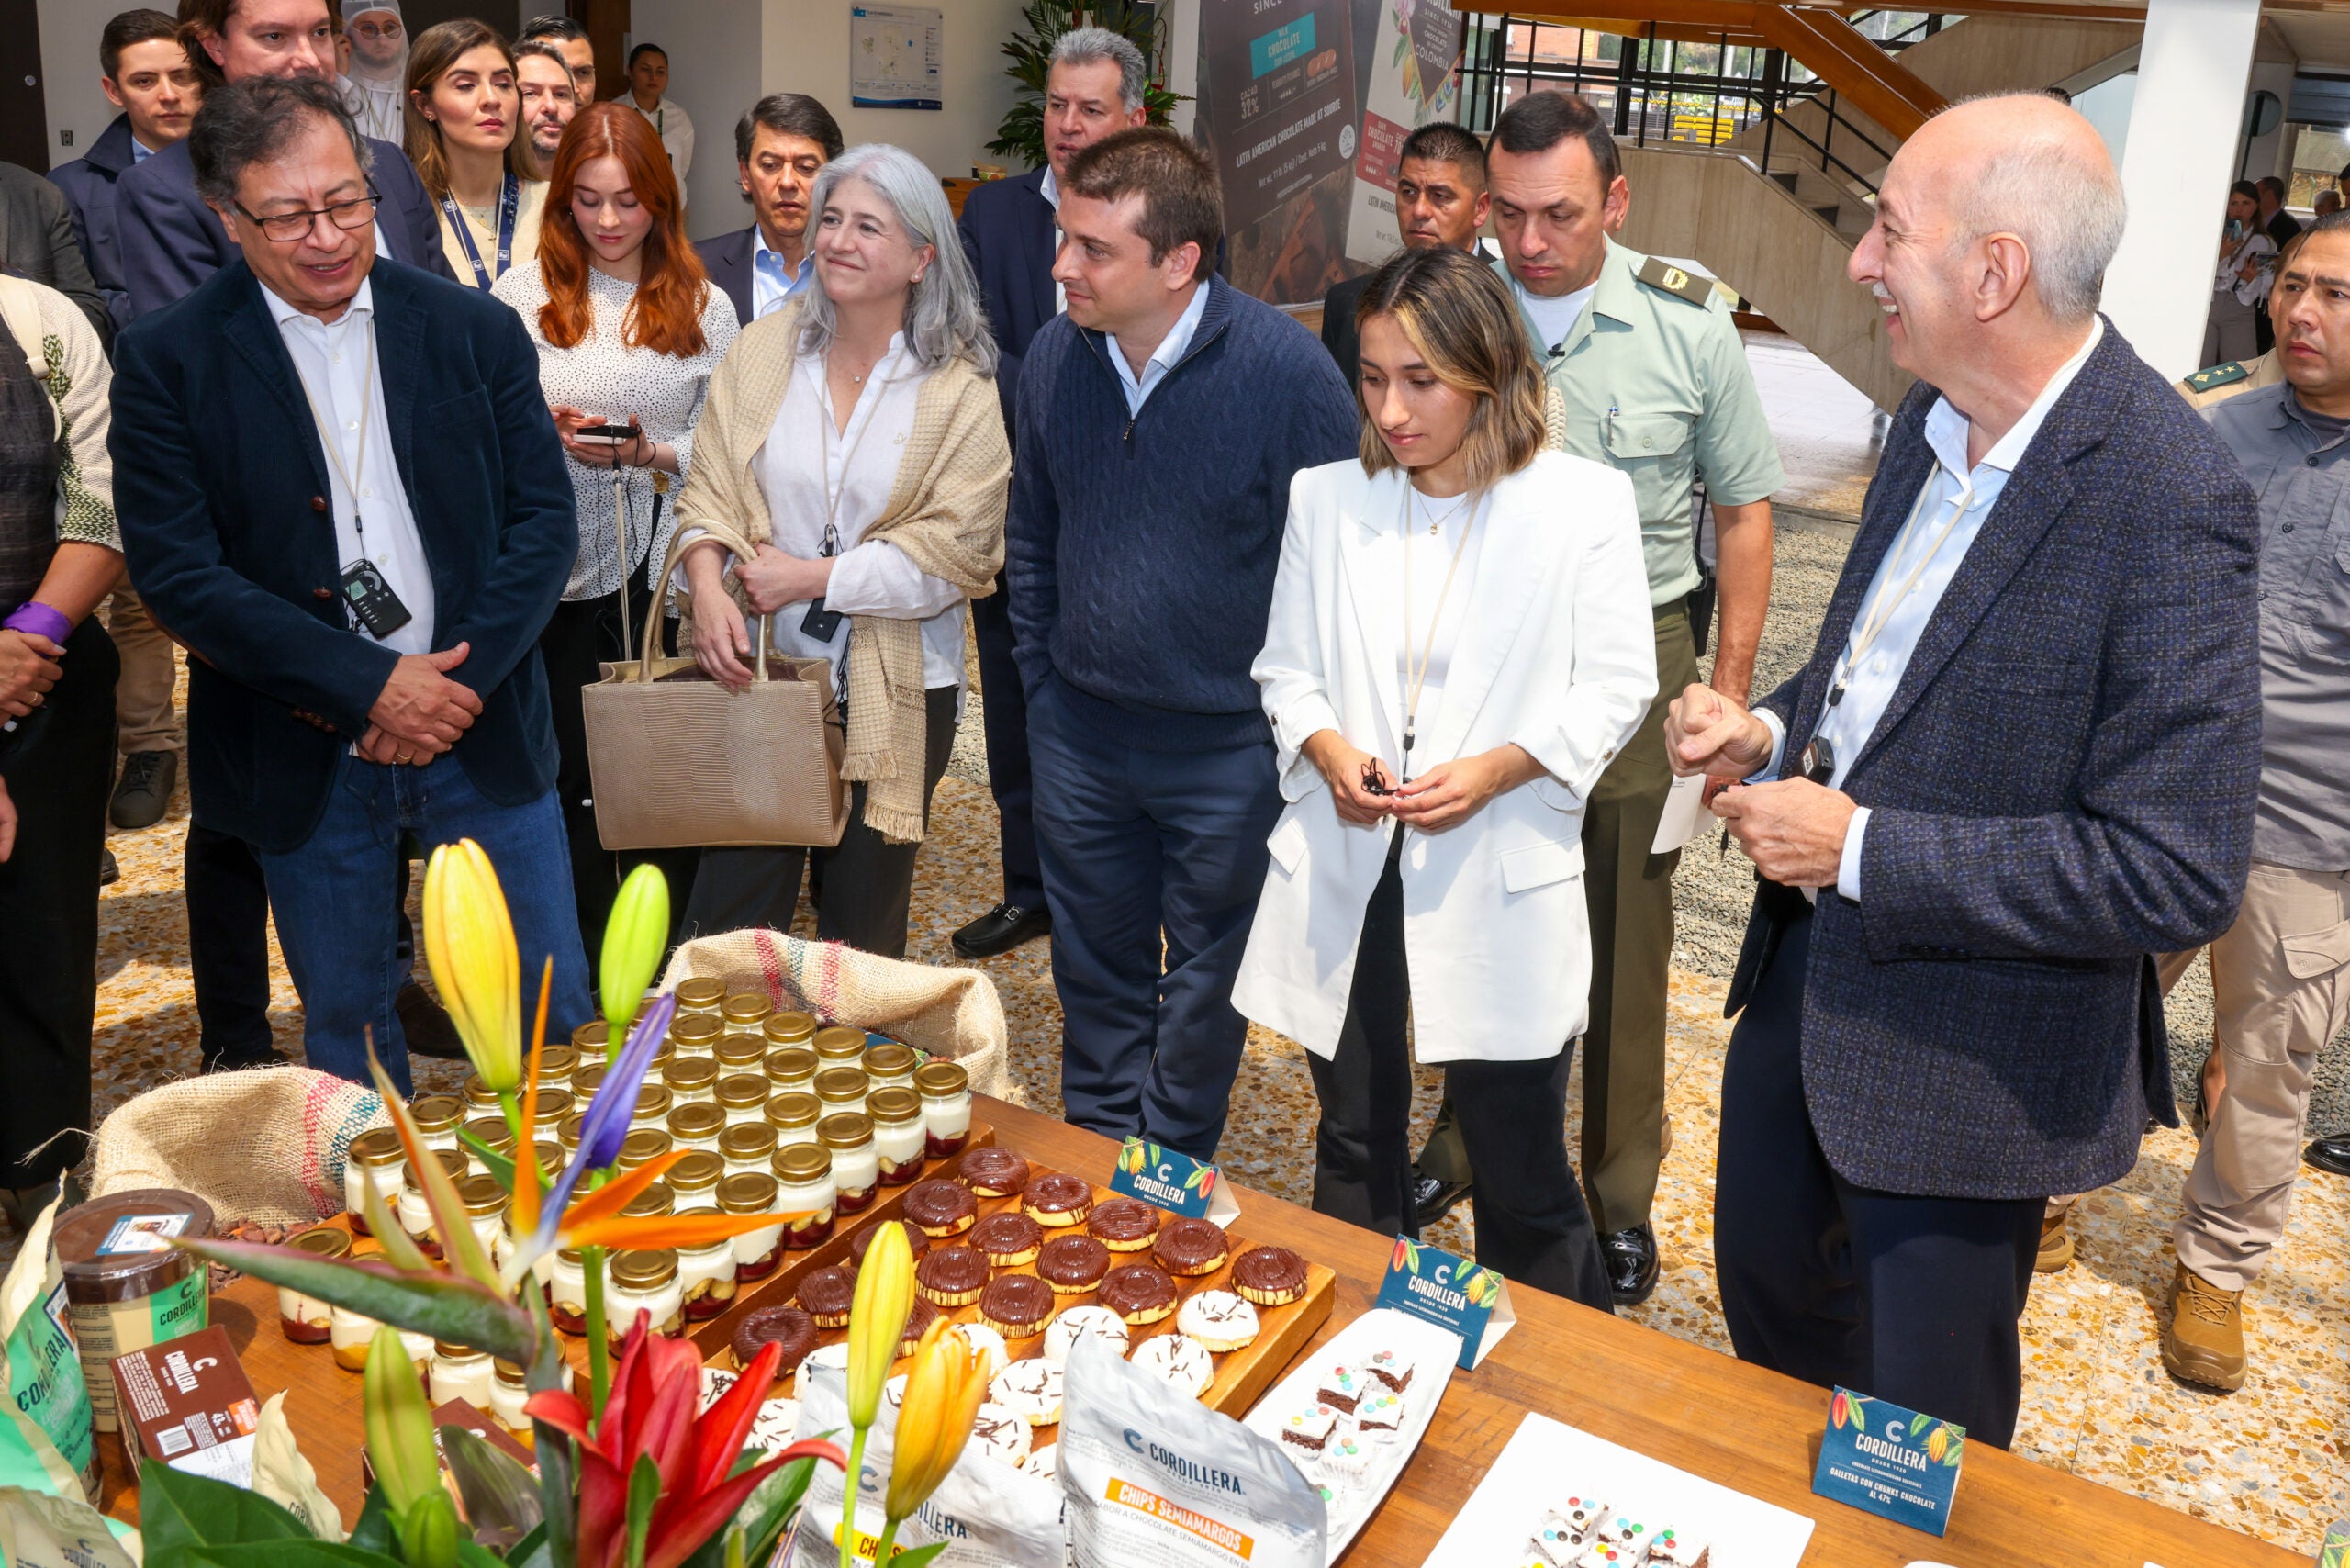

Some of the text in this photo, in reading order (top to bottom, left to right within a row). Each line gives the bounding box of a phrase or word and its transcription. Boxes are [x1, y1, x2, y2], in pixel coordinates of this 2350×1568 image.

[1425, 8, 1439, 22] SINCE
[1268, 32, 1300, 58] CHOCOLATE
[1416, 44, 1449, 71] COLOMBIA
[1241, 84, 1258, 101] CACAO
[1241, 97, 1259, 119] 32%
[1237, 98, 1340, 167] LATIN AMERICAN CHOCOLATE MADE AT SOURCE
[1368, 126, 1393, 147] CHOCOLATE
[1393, 140, 1404, 155] 70
[1133, 1175, 1186, 1204] CORDILLERA
[160, 1287, 205, 1326] CORDILLERA
[1408, 1275, 1465, 1311] CORDILLERA
[1419, 1297, 1436, 1307] DESDE
[164, 1350, 199, 1394] CORDILLERA
[1855, 1433, 1927, 1472] CORDILLERA
[1871, 1458, 1907, 1473] DESDE 1920
[1150, 1443, 1241, 1495] CORDILLERA
[1166, 1468, 1193, 1485] DESDE
[1830, 1467, 1935, 1509] GALLETAS CON CHUNKS CHOCOLATE
[1869, 1490, 1877, 1499] AL
[1119, 1484, 1156, 1512] CHIPS
[1158, 1498, 1241, 1551] SEMIAMARGOS
[1130, 1513, 1178, 1536] CHOCOLATE
[1179, 1532, 1228, 1561] SEMIAMARGO
